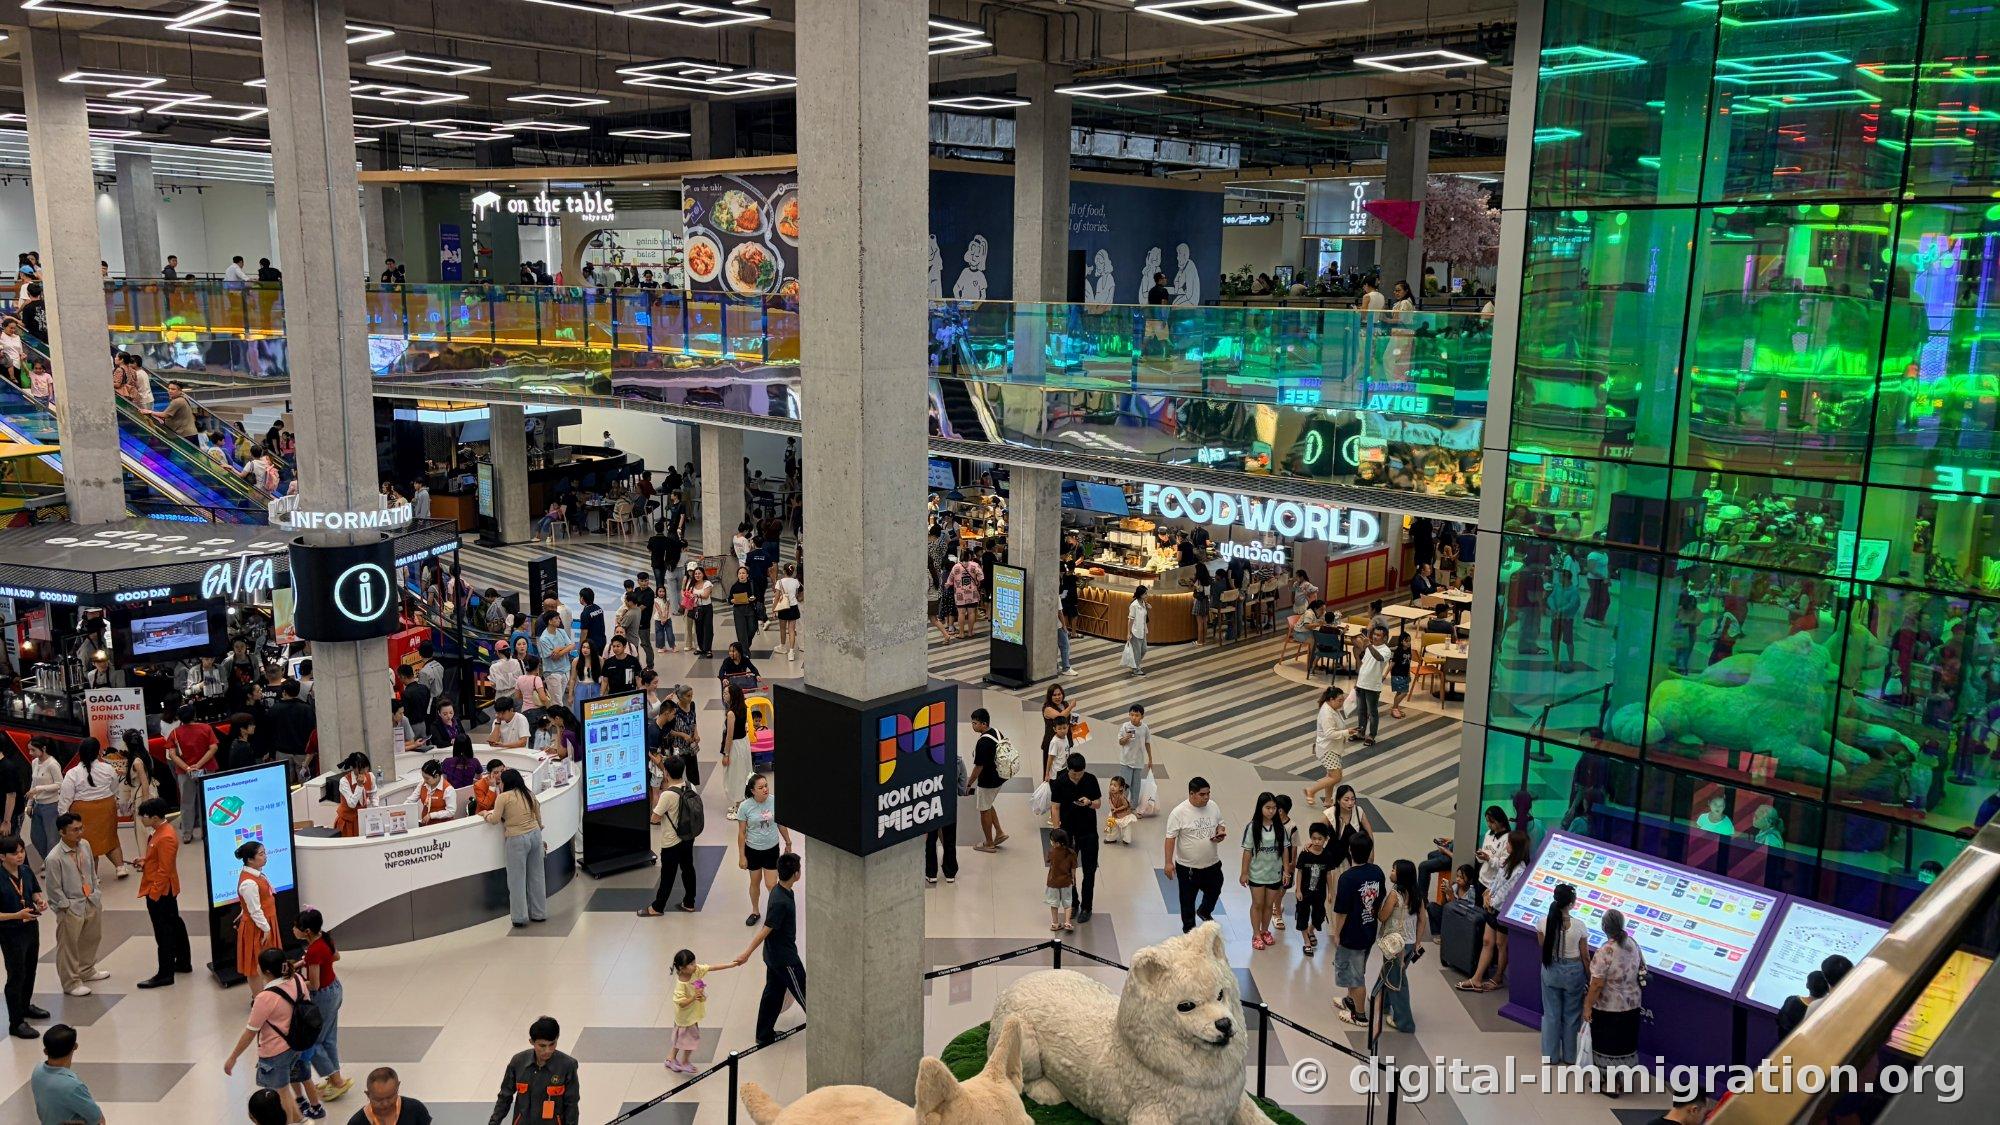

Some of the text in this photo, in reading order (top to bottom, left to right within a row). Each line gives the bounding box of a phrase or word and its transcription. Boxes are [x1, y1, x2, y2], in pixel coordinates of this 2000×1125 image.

[507, 190, 614, 213] on the table
[1085, 203, 1106, 218] food,
[1082, 220, 1110, 232] stories.
[115, 587, 171, 602] GOOD DAY
[89, 694, 122, 703] GAGA
[90, 703, 141, 712] SIGNATURE
[91, 713, 125, 721] DRINKS
[878, 774, 944, 811] KOK KOK
[877, 795, 944, 839] MEGA
[385, 852, 443, 869] INFORMATION
